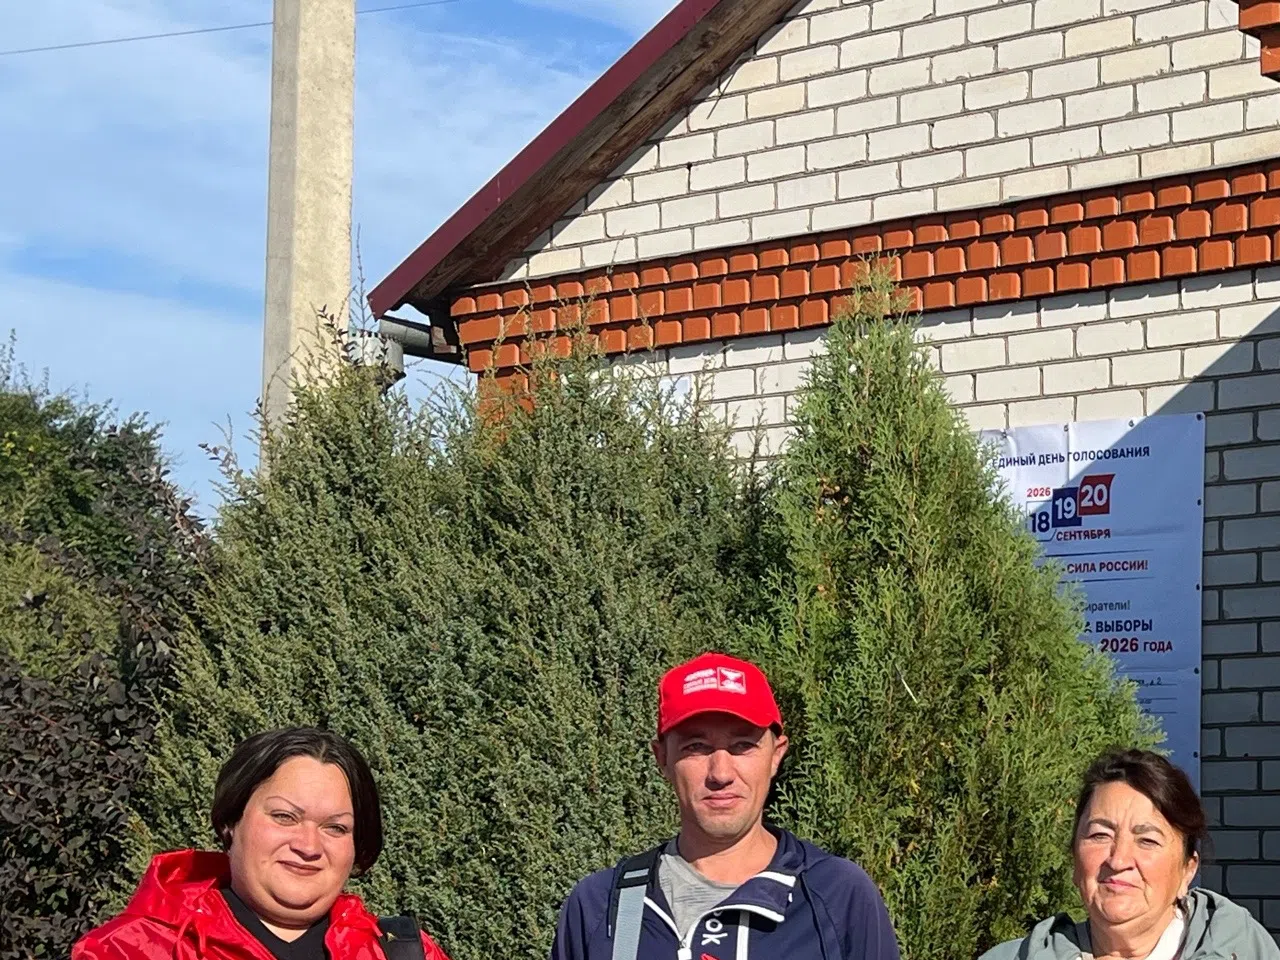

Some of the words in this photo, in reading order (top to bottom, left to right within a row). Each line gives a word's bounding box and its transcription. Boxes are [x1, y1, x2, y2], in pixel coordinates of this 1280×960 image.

[992, 453, 1036, 469] ЕДИНЫЙ
[1038, 453, 1065, 466] ДЕНЬ
[1067, 446, 1150, 461] ГОЛОСОВАНИЯ
[1026, 487, 1051, 498] 2026
[1080, 483, 1108, 507] 20
[1055, 496, 1077, 520] 19
[1030, 511, 1050, 533] 18
[1056, 528, 1111, 541] СЕНТЯБРЯ
[1067, 562, 1097, 574] СИЛА
[1099, 560, 1148, 573] РОССИИ!
[1095, 619, 1153, 633] ВЫБОРЫ
[1100, 637, 1139, 653] 2026
[1143, 641, 1173, 653] ГОДА
